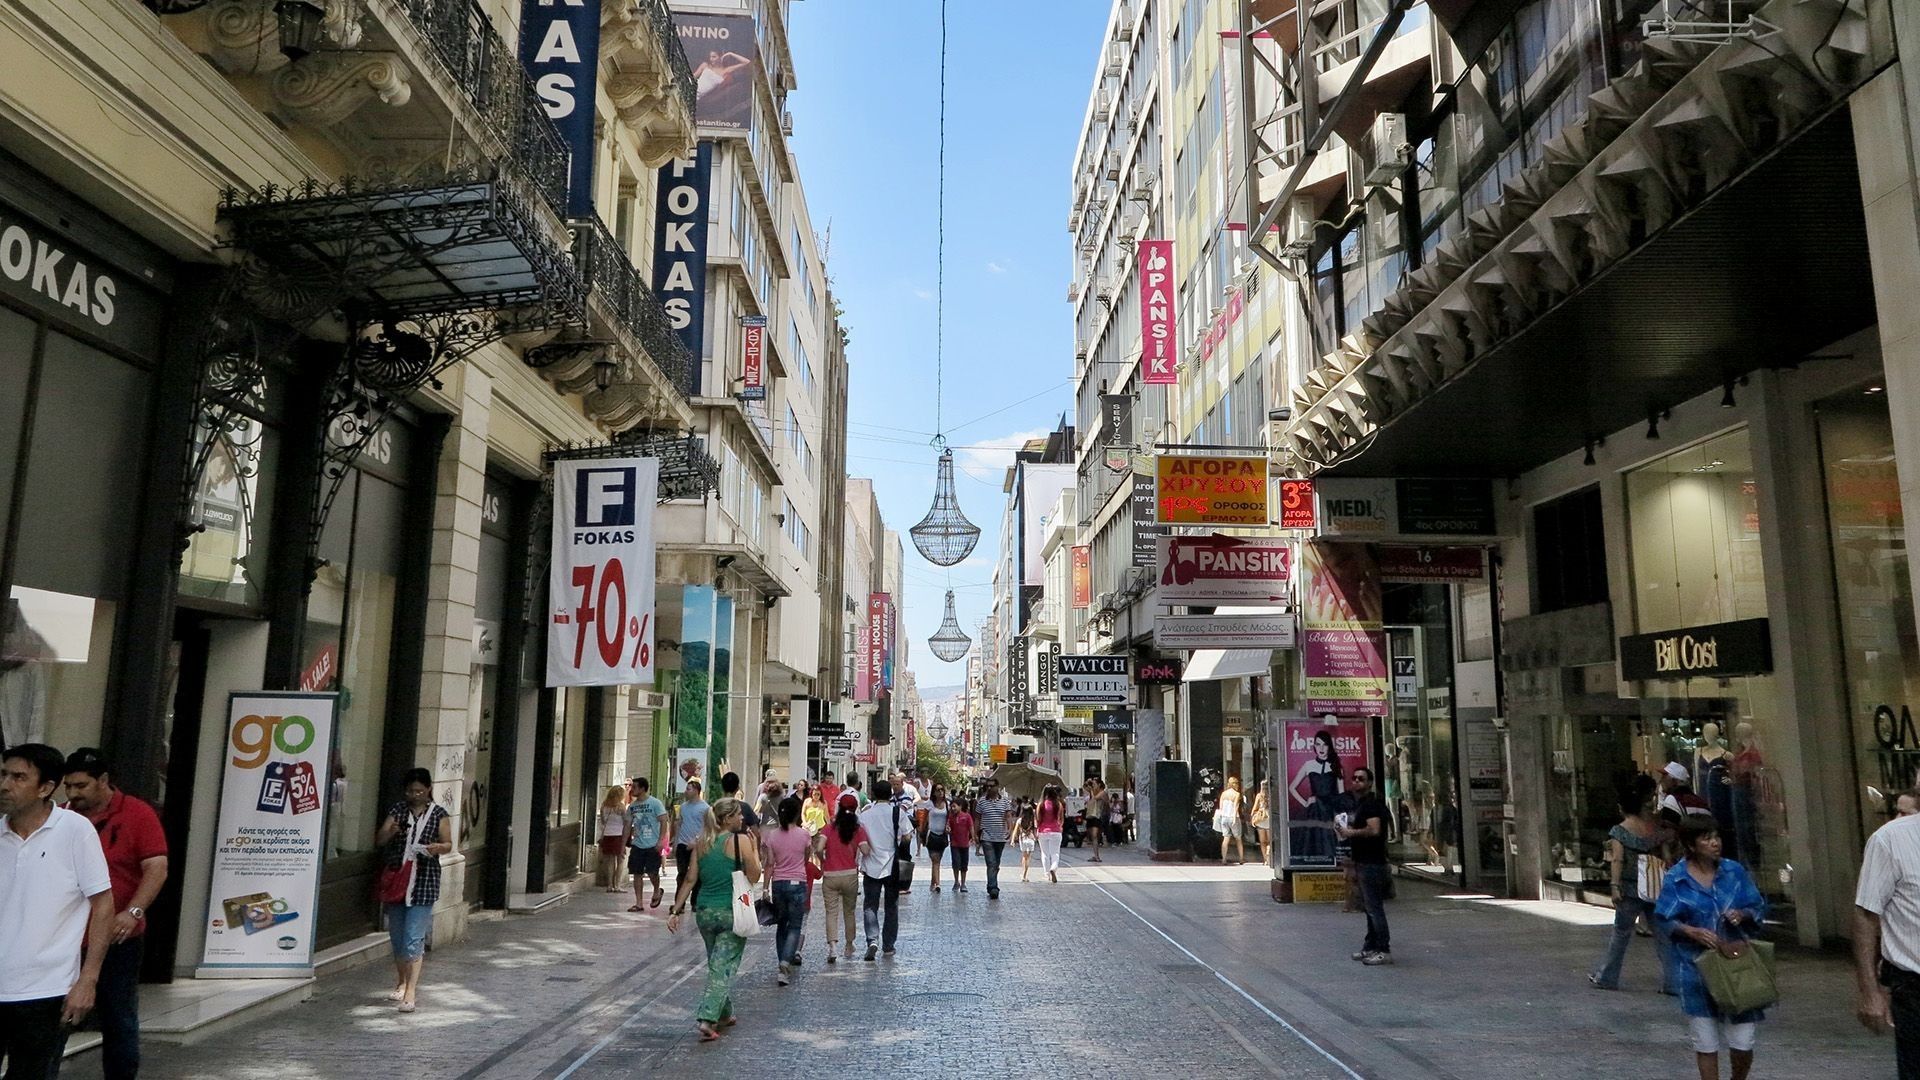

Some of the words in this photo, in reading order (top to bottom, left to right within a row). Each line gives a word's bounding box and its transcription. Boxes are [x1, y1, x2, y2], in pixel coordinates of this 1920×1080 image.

[664, 147, 698, 330] FOKAS
[1, 225, 116, 326] OKAS
[1170, 459, 1256, 476] ΑΓΟΡΑ
[1162, 477, 1265, 494] ΧΡΥΣΟΥ
[1213, 501, 1266, 511] ΟΡΟΦΟΣ
[1284, 510, 1312, 518] ΑΓΟΡΑ
[1283, 519, 1315, 528] ΧΡΥΣΟΥ
[574, 531, 635, 545] FOKAS
[1416, 551, 1432, 563] 16
[553, 557, 649, 669] -70%
[872, 614, 881, 645] HOUSE
[1308, 632, 1339, 643] Bella
[857, 629, 869, 674] ESPRIT
[1654, 638, 1680, 672] Bill
[1680, 634, 1719, 670] Cost
[1018, 639, 1027, 702] SEPHOR
[1062, 659, 1126, 672] WATCH
[1306, 737, 1361, 750] PSiK
[290, 772, 318, 799] 5%
